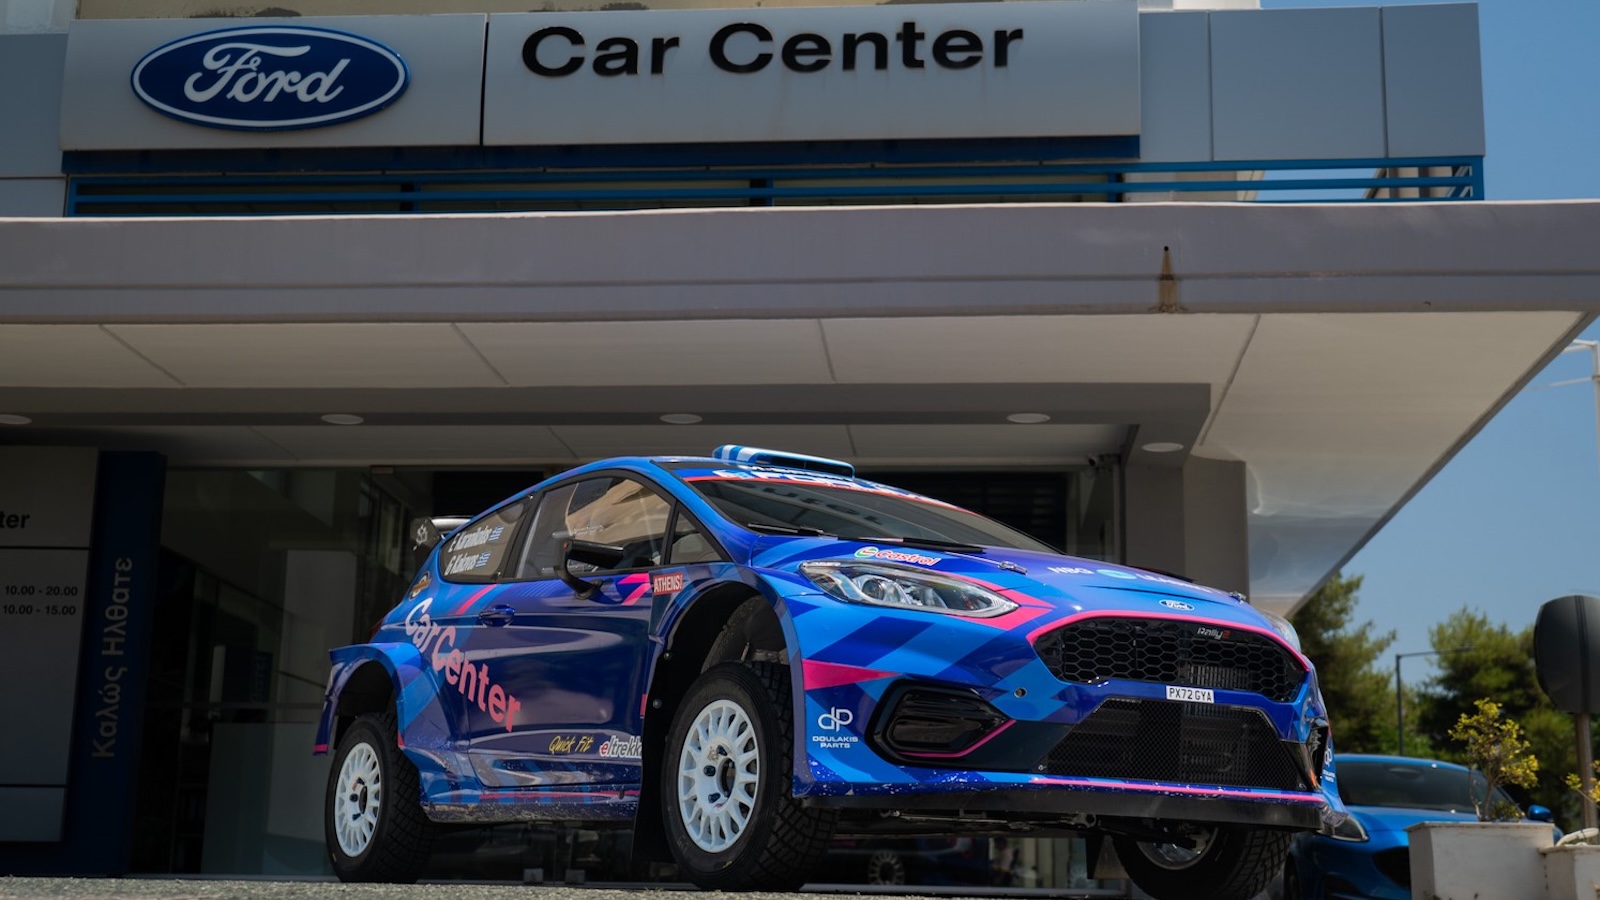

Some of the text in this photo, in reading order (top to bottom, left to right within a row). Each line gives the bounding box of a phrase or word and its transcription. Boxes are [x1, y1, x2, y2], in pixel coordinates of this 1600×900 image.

[522, 22, 1024, 77] Car Center
[184, 42, 350, 103] Ford
[876, 550, 941, 566] Castrol
[5, 585, 35, 596] 10.00
[46, 585, 78, 596] 20.00
[654, 574, 683, 593] ATHENS!
[3, 604, 33, 615] 10.00
[45, 605, 76, 616] 15.00
[1169, 687, 1212, 702] PX72 GYA
[92, 666, 129, 758] Καλώς
[548, 735, 594, 755] Quick Fit
[599, 735, 643, 758] eltrekk
